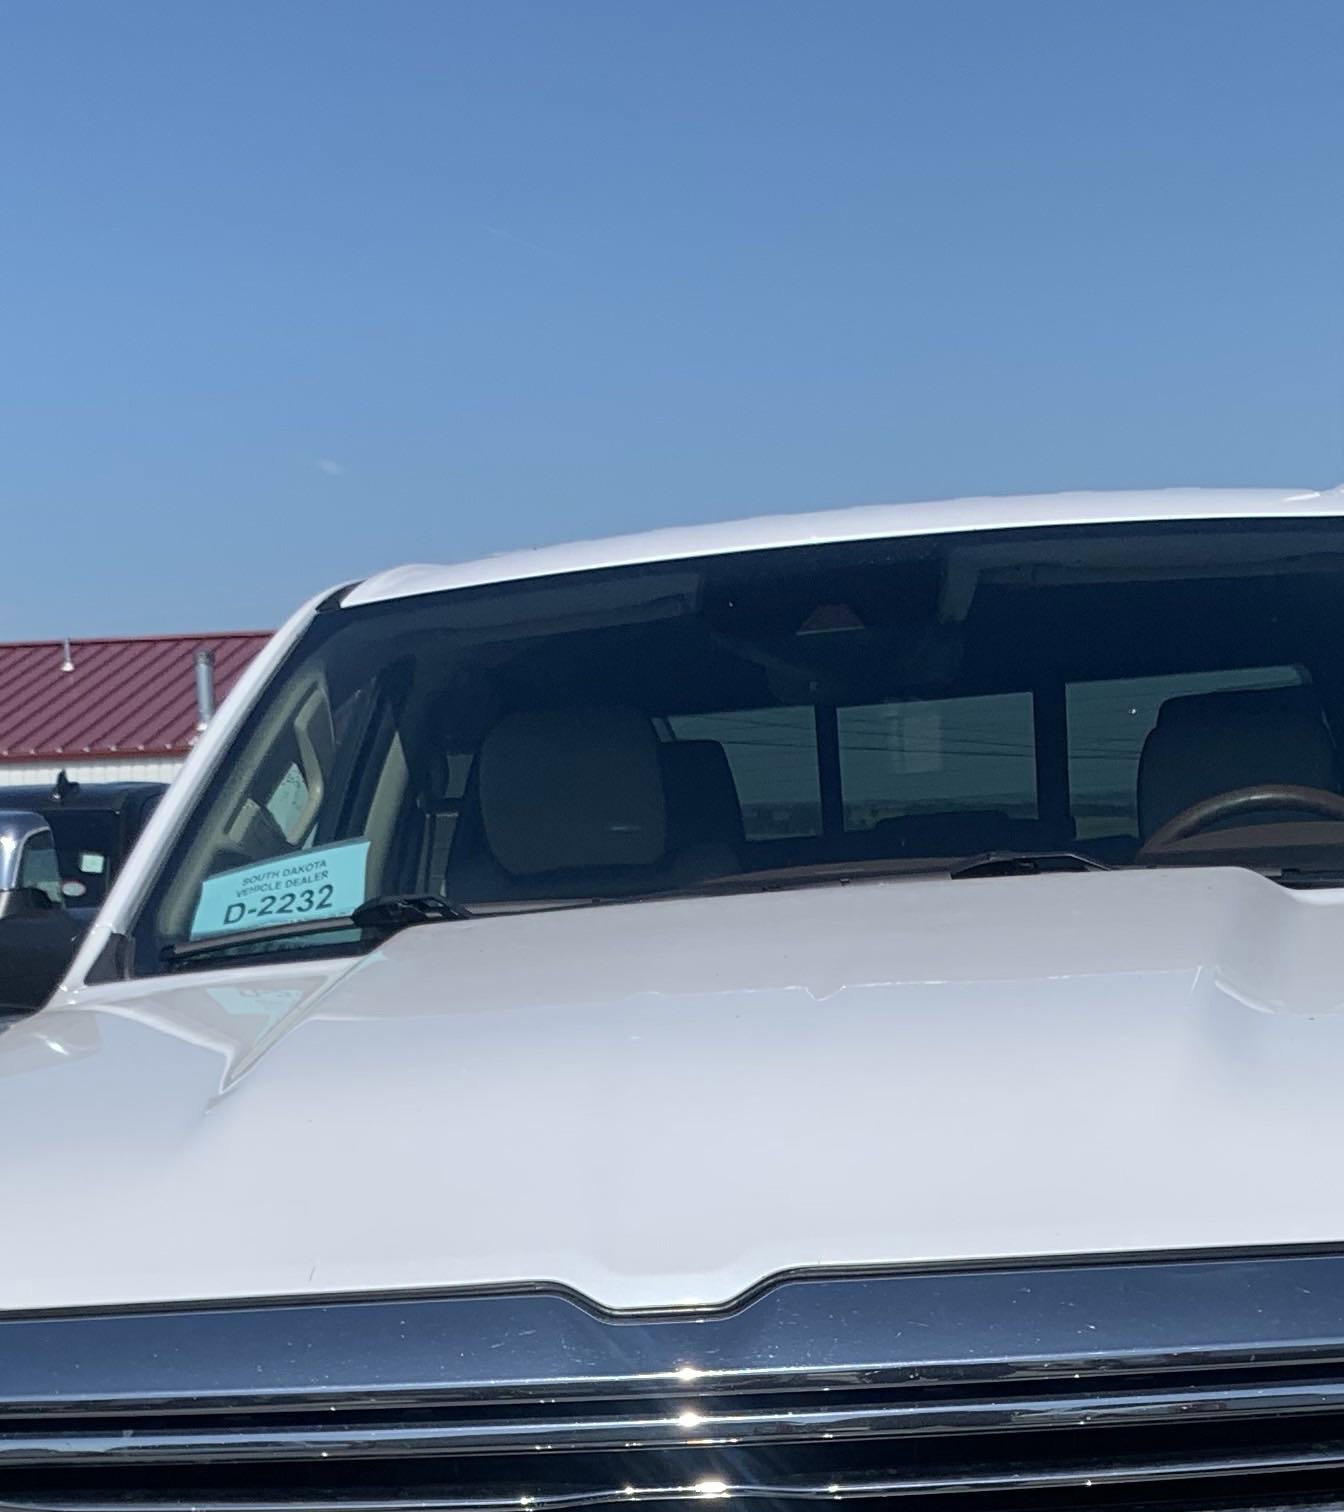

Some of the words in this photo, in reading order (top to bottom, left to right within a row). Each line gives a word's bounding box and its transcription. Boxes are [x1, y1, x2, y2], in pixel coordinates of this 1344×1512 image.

[235, 880, 281, 898] VEHICLE
[285, 870, 329, 888] DEALER
[241, 870, 281, 886] SOUTH
[283, 859, 327, 876] DAKOTA
[223, 884, 334, 924] D-2232
